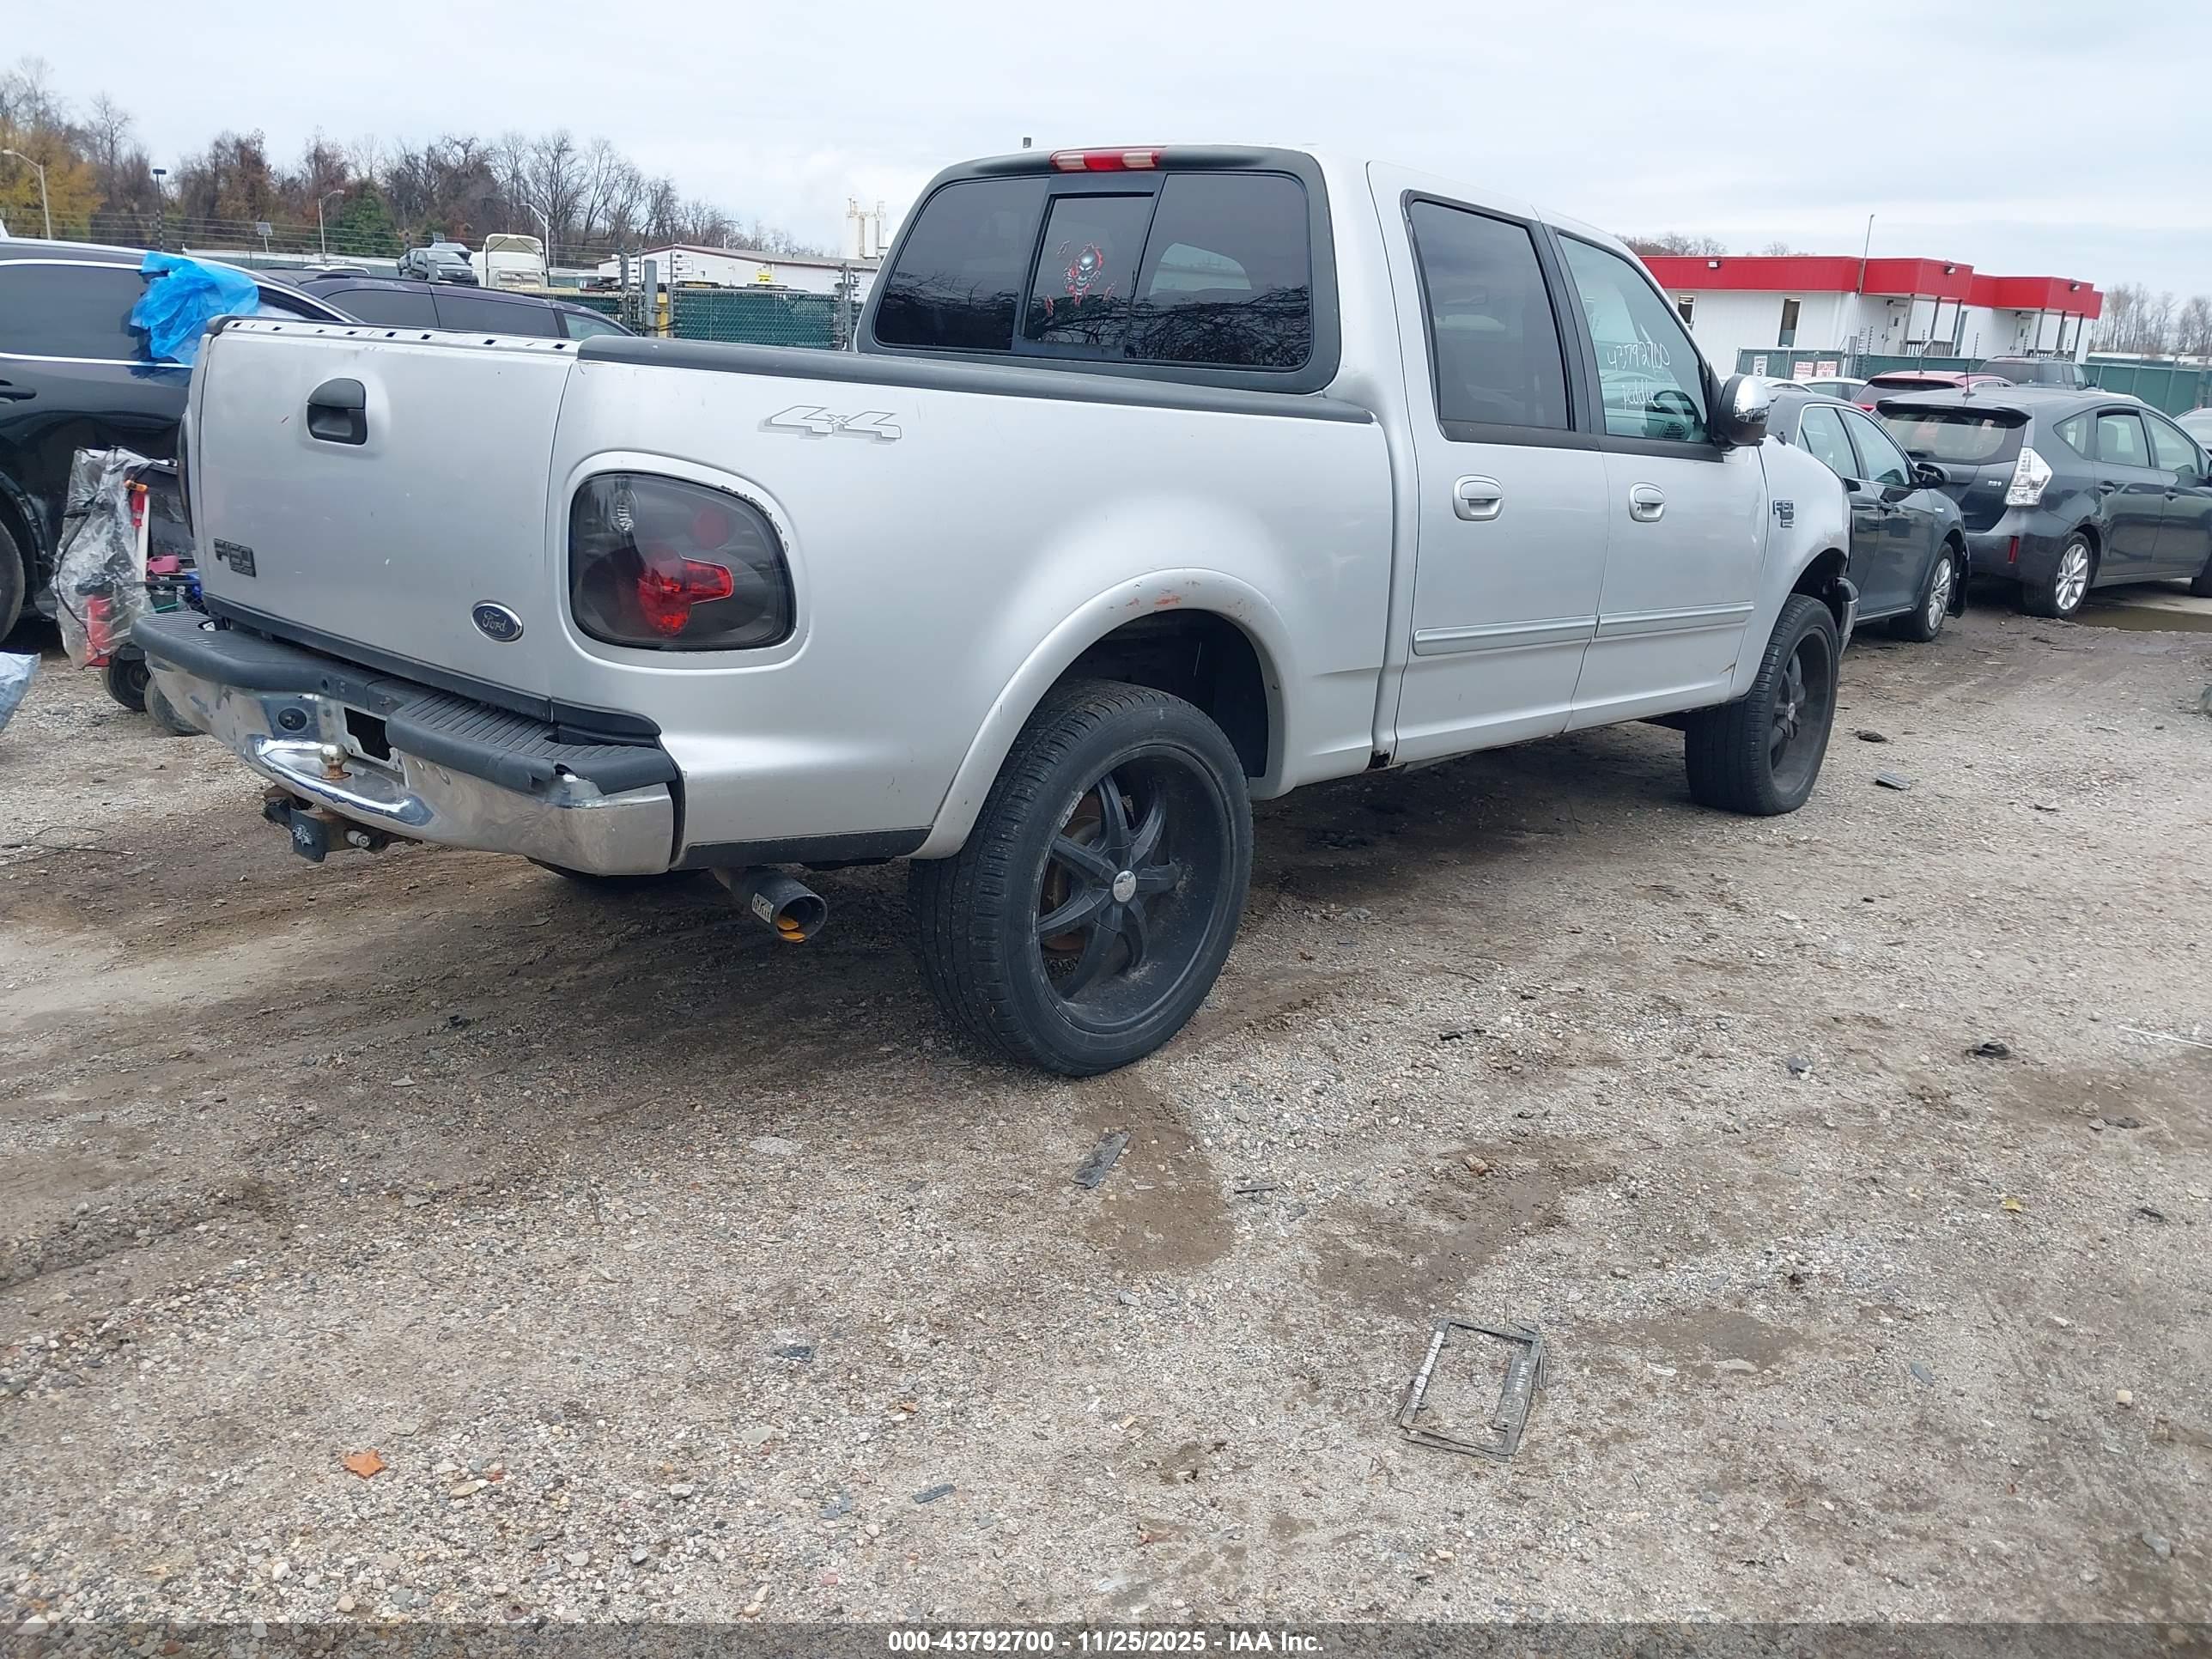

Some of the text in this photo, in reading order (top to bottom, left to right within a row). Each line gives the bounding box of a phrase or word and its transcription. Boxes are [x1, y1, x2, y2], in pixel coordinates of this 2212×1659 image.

[1607, 341, 1670, 370] 43792700
[1757, 368, 1763, 377] 5
[482, 610, 507, 633] Ford
